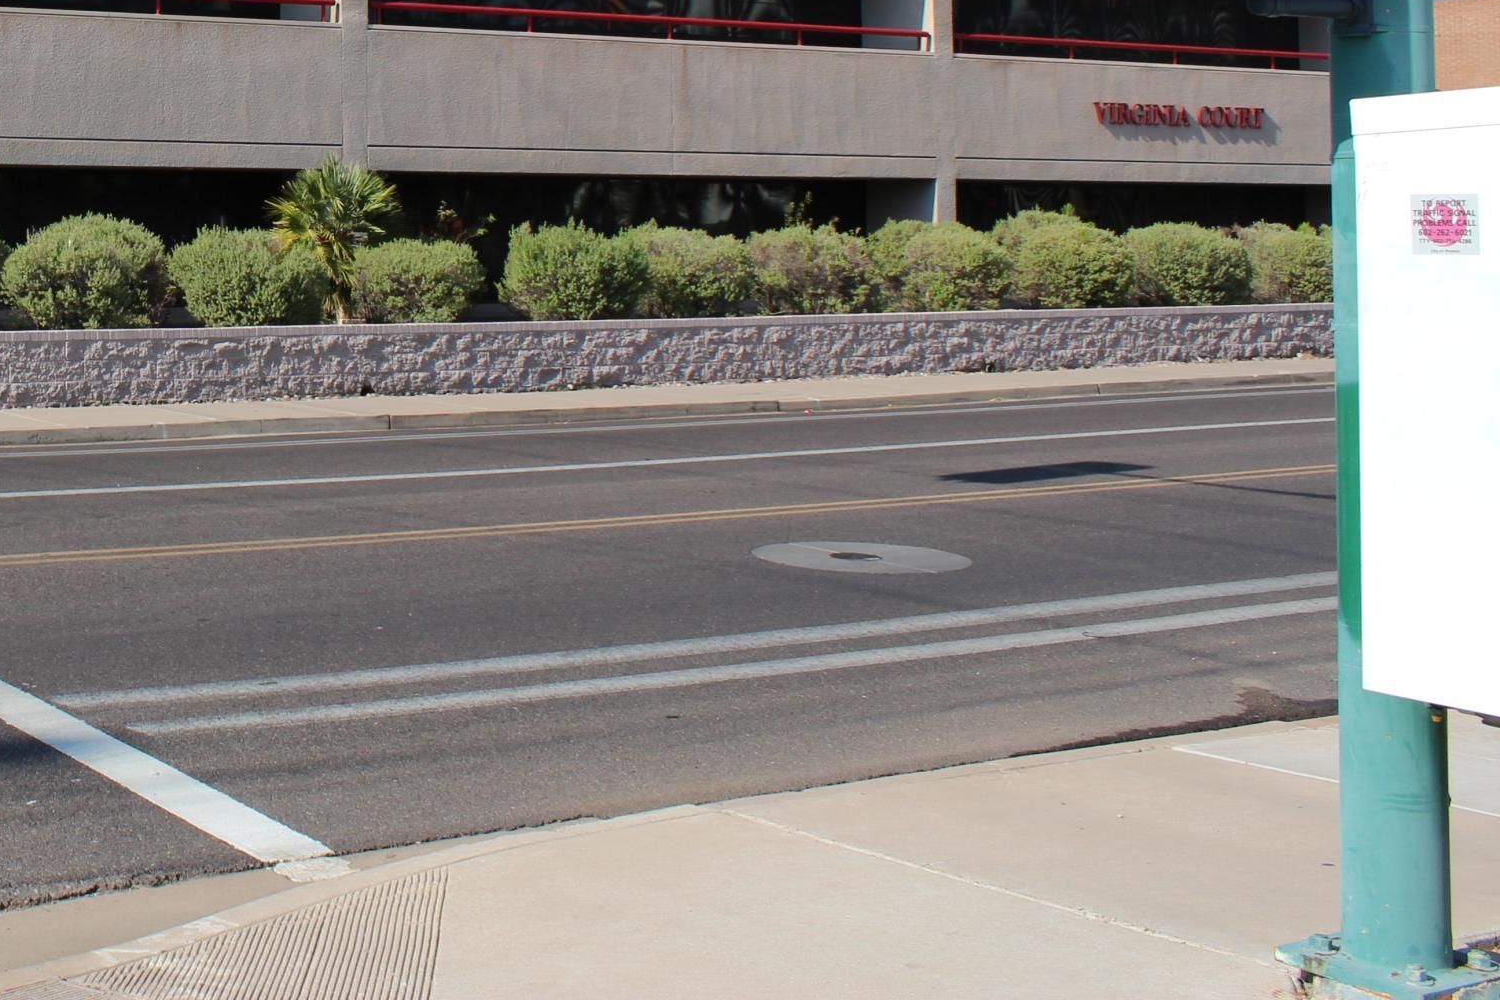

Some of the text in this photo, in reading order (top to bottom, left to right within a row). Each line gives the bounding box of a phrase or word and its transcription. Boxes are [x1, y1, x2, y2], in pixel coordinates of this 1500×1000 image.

[1093, 102, 1264, 129] VIRGINIA COURT
[1420, 199, 1467, 207] TO REPORT
[1412, 209, 1477, 217] TRAFFIC SIGNAL
[1412, 219, 1477, 227] PROBLEMS CALL
